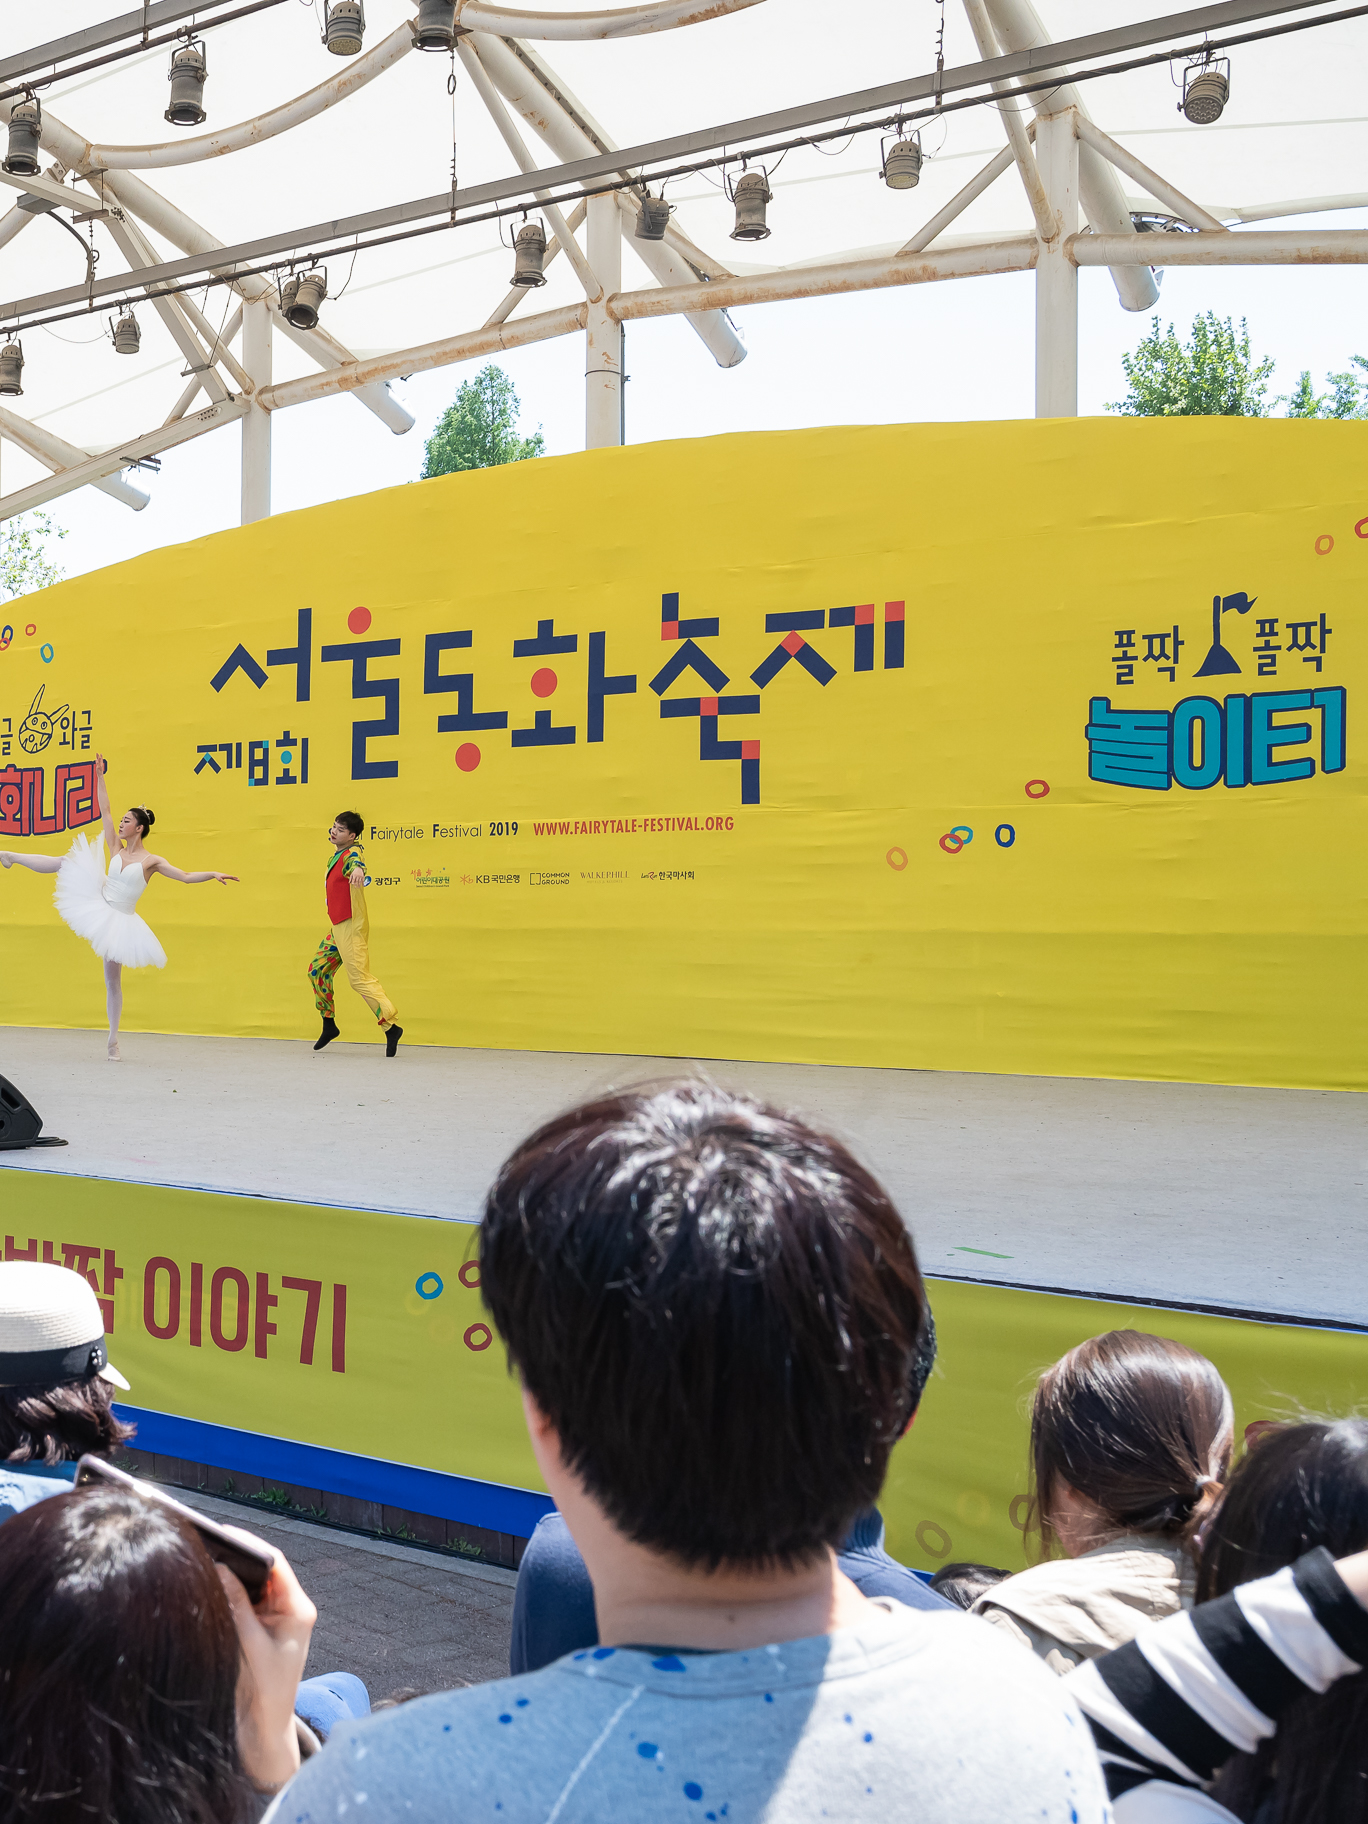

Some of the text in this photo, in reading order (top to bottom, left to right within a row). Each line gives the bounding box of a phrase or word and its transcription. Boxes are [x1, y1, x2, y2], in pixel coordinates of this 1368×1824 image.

[1111, 613, 1332, 685] 폴짝 폴짝
[193, 592, 905, 805] 제8회 서울동화축제
[59, 710, 93, 750] 와글
[1085, 686, 1347, 791] 놀이터
[370, 826, 424, 843] Fairytale
[432, 824, 482, 838] Festival
[489, 822, 519, 836] 2019
[533, 816, 735, 836] WWW.FAIRYTALE-FESTIVAL.ORG
[374, 877, 401, 886] 광진구
[475, 874, 521, 884] KB국민은행
[580, 870, 630, 879] WALKERHILL
[659, 870, 695, 881] 한국마사회
[143, 1256, 347, 1374] 이야기
